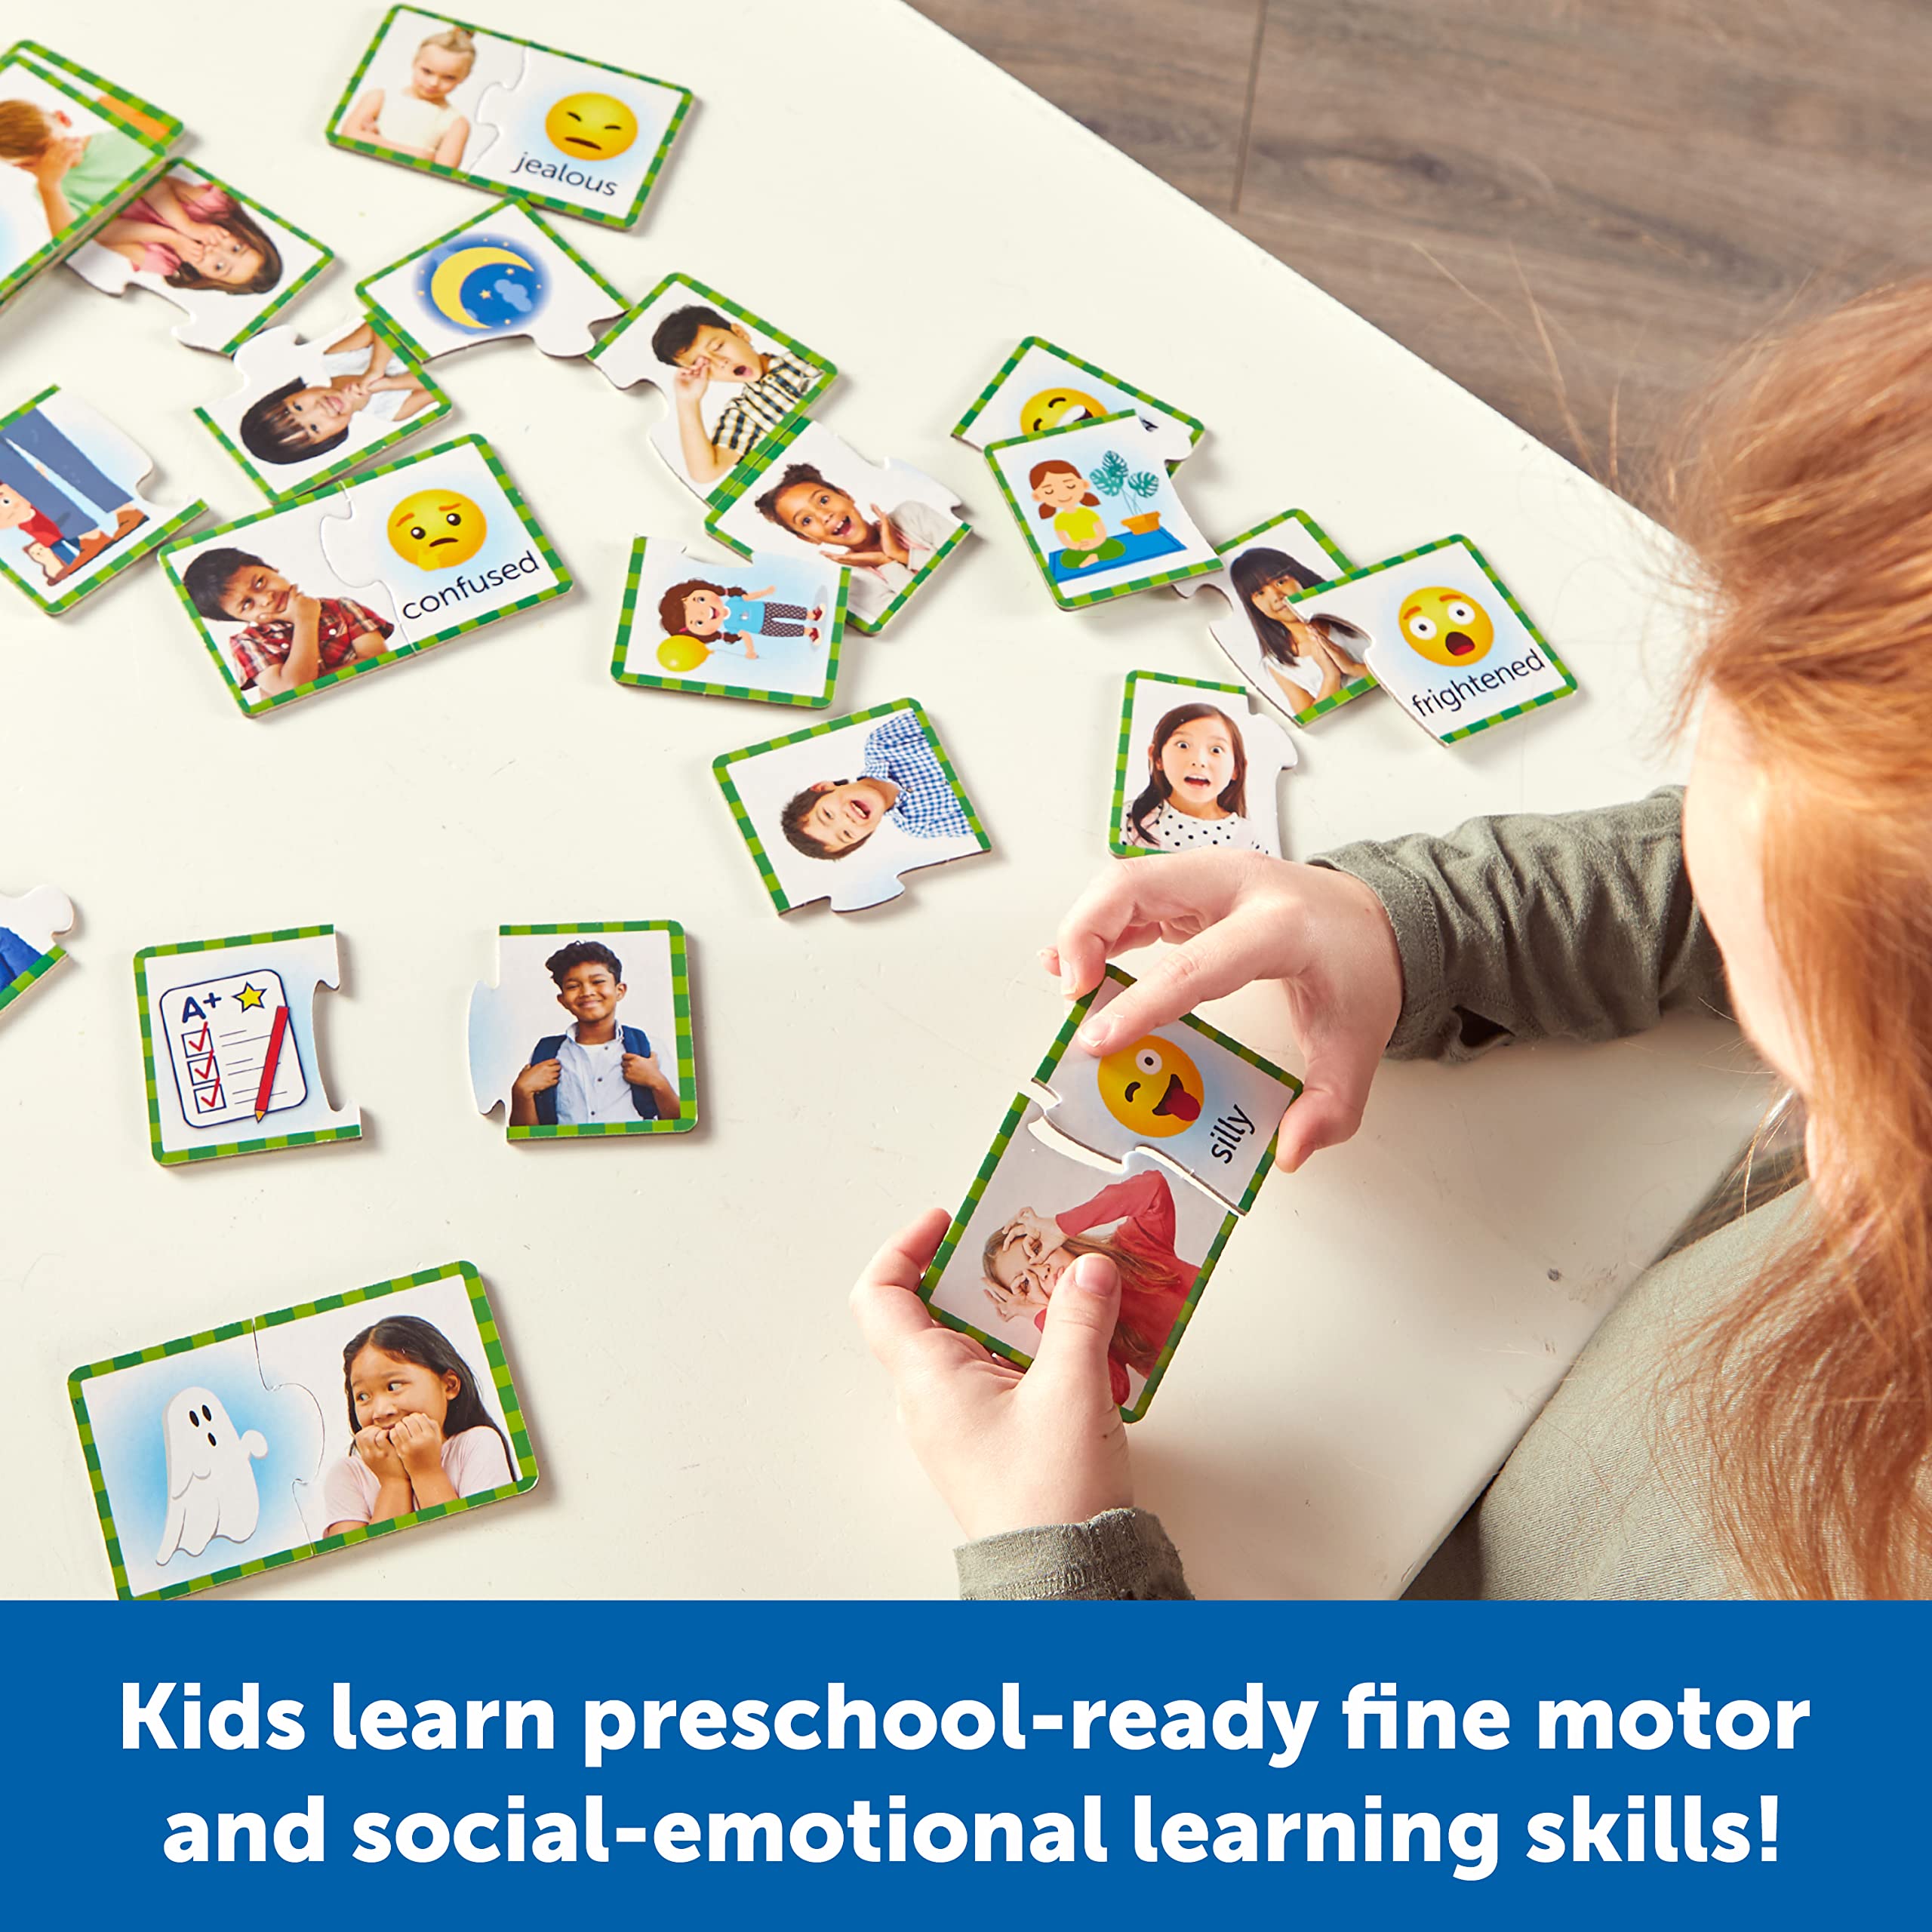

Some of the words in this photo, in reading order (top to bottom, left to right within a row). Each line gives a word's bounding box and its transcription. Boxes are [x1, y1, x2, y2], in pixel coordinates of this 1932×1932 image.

[510, 151, 618, 196] jealous
[402, 549, 540, 619] confused
[1411, 648, 1546, 717] frightened
[182, 992, 222, 1023] A+
[1210, 1103, 1255, 1164] silly
